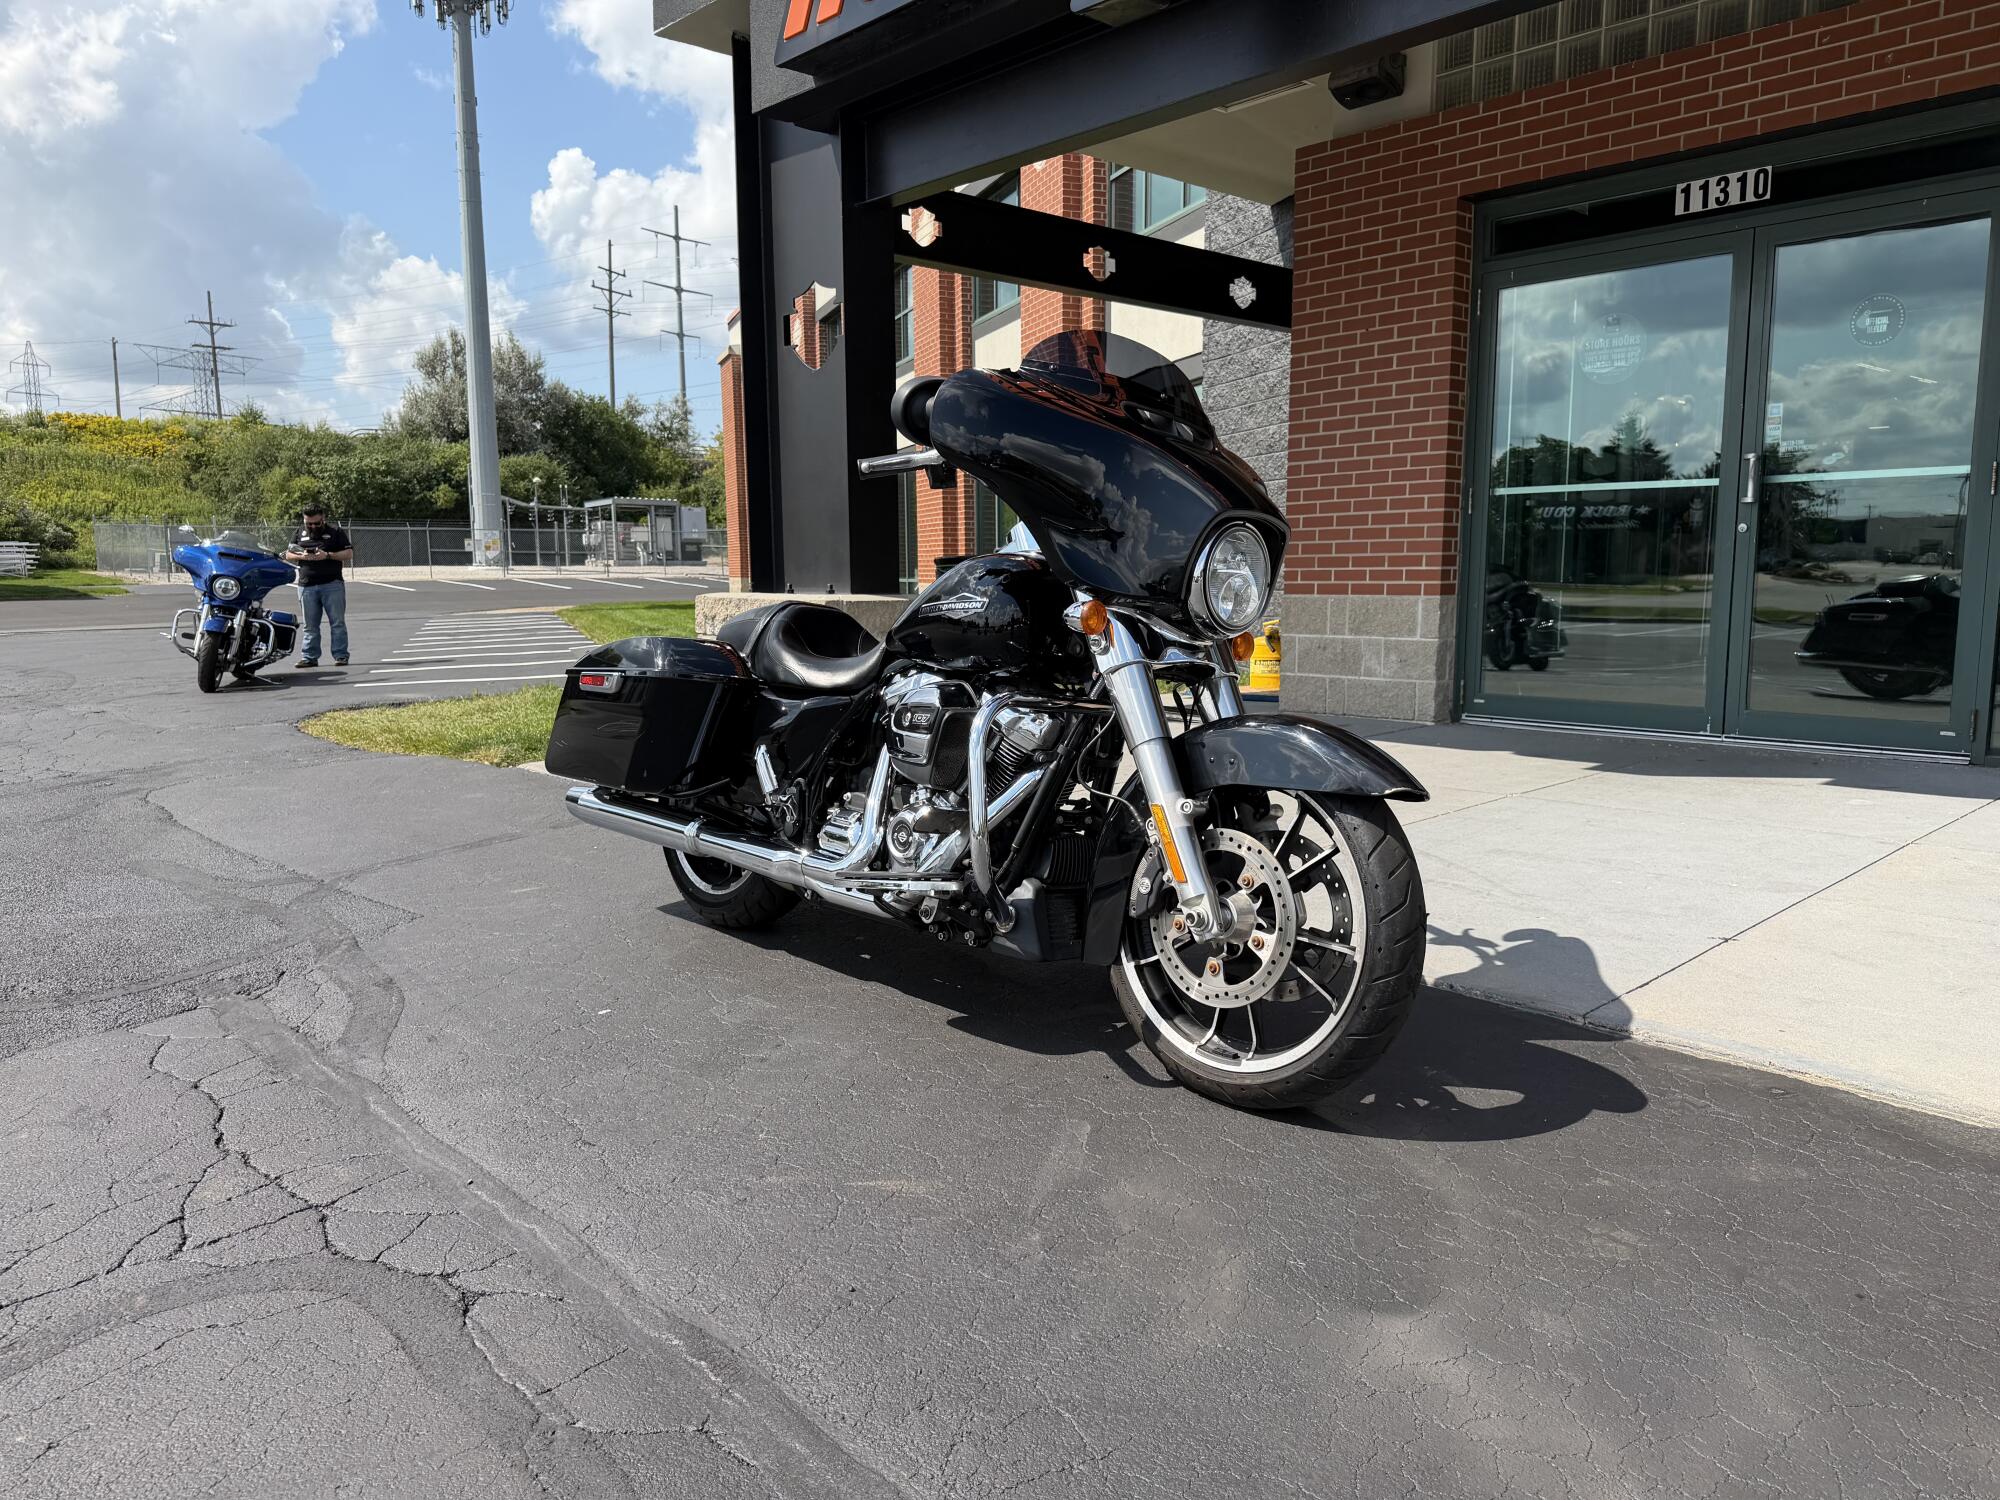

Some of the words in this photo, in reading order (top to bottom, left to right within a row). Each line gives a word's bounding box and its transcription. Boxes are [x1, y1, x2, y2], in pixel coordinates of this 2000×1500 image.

[1680, 167, 1770, 213] 11310
[1584, 337, 1610, 350] STORE
[1612, 334, 1641, 347] HOURS
[912, 713, 931, 723] 107
